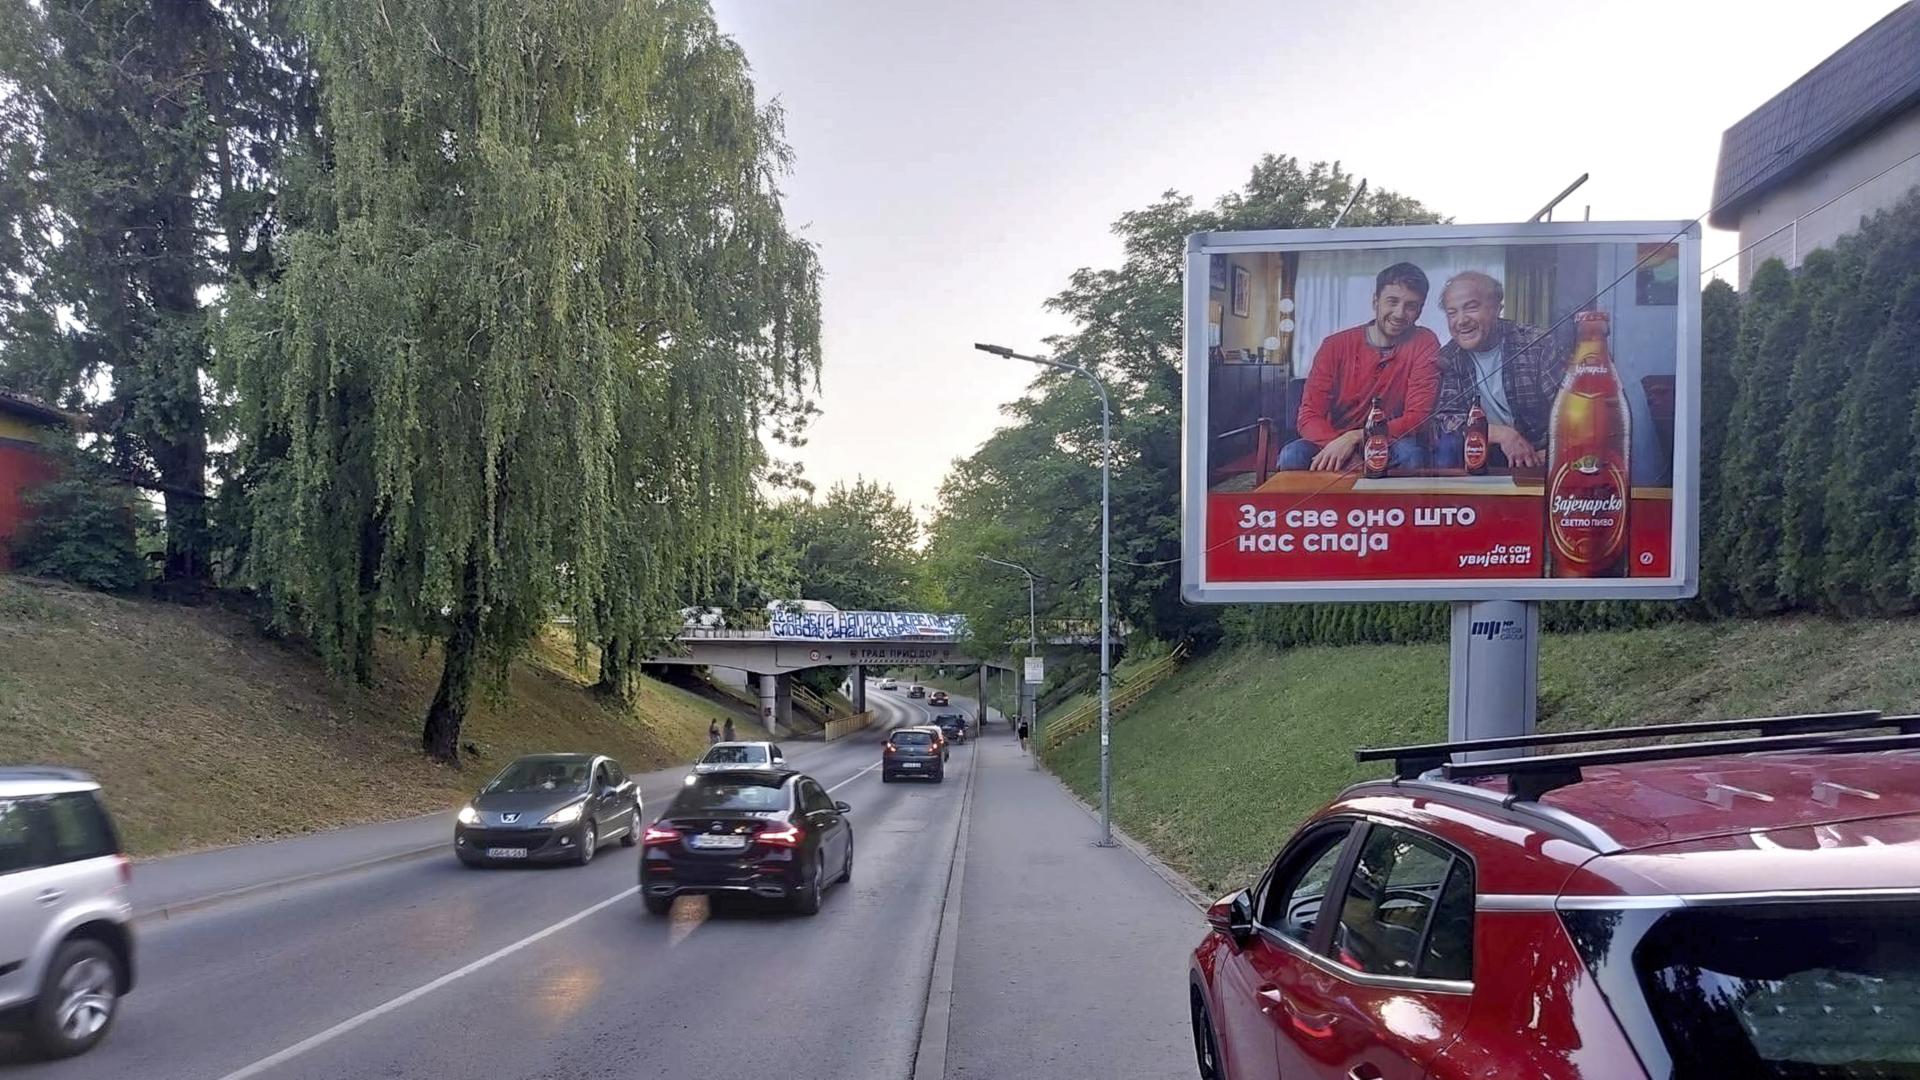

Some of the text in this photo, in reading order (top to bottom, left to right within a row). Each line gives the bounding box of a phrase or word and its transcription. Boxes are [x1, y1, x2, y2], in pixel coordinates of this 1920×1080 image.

[1239, 504, 1476, 528] За све оно што
[1560, 518, 1590, 527] СВЕТЛО
[1239, 527, 1389, 557] нас спаја
[1491, 544, 1531, 554] Ја сам
[1459, 551, 1508, 567] увијек
